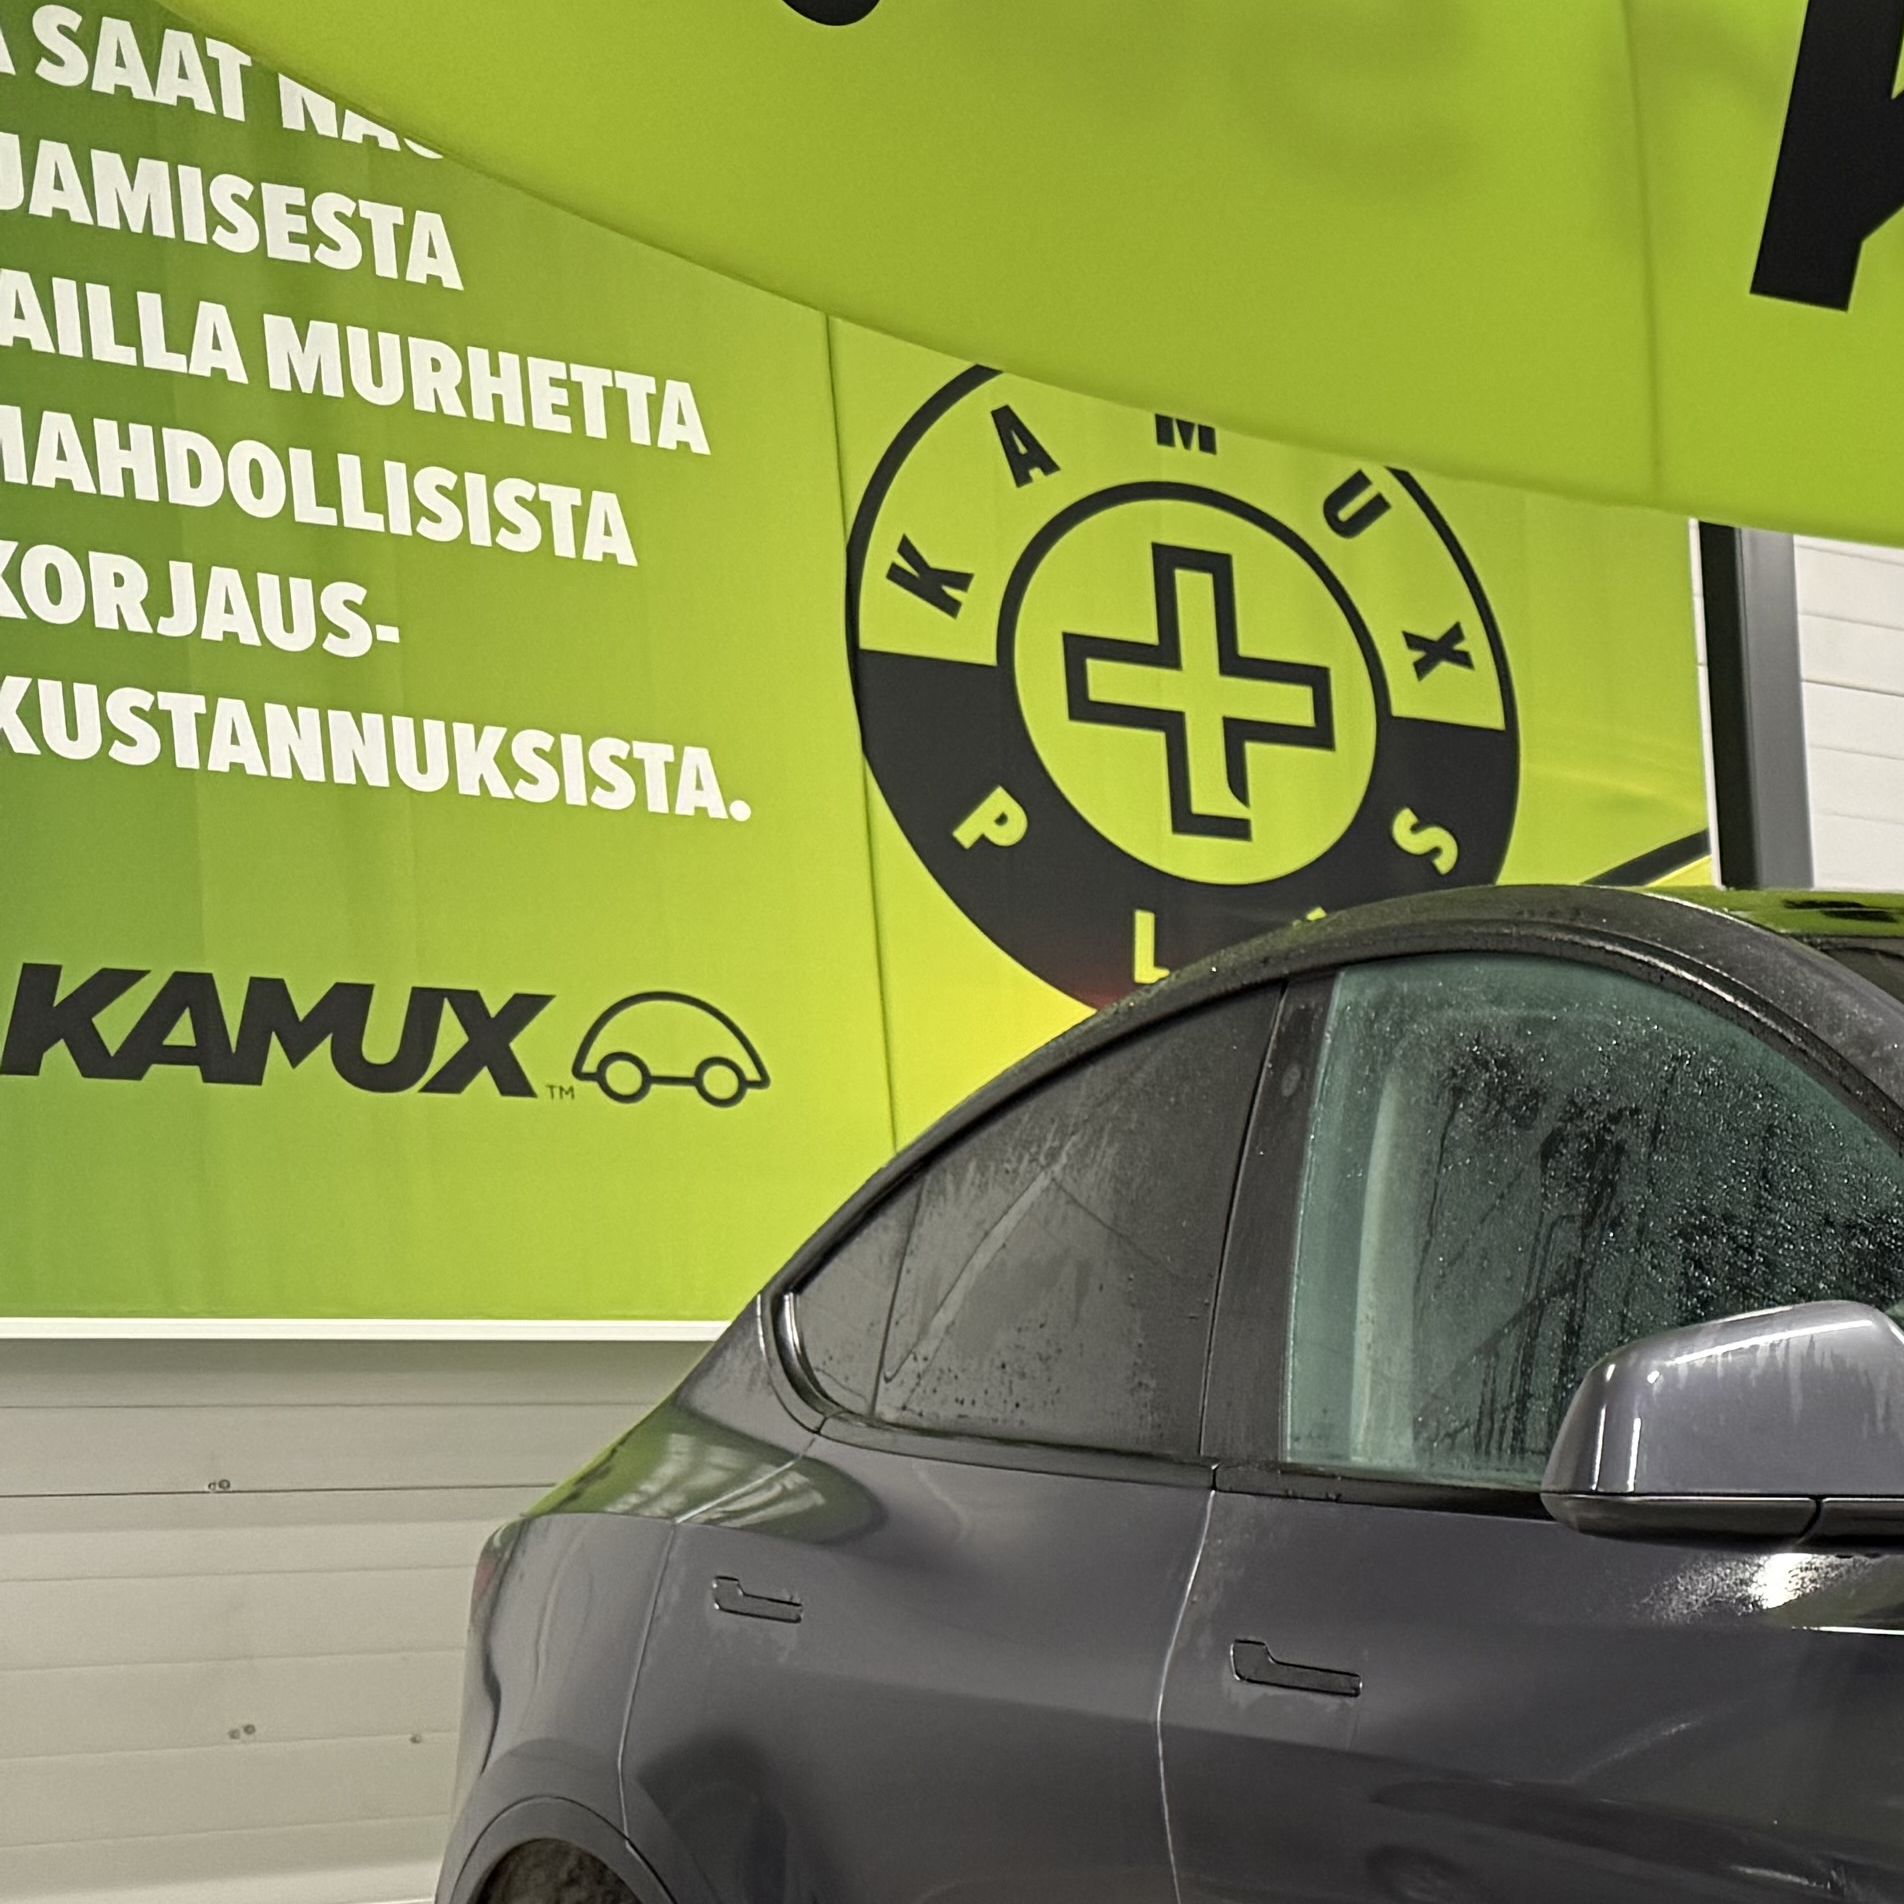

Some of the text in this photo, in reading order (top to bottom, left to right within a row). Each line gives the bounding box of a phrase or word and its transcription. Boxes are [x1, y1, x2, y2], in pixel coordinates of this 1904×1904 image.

[32, 4, 252, 122] SAAT
[263, 313, 711, 455] MURHETTA
[885, 404, 1475, 682] KAMUX
[953, 786, 1459, 984] PLS
[2, 963, 556, 1099] KAMUX
